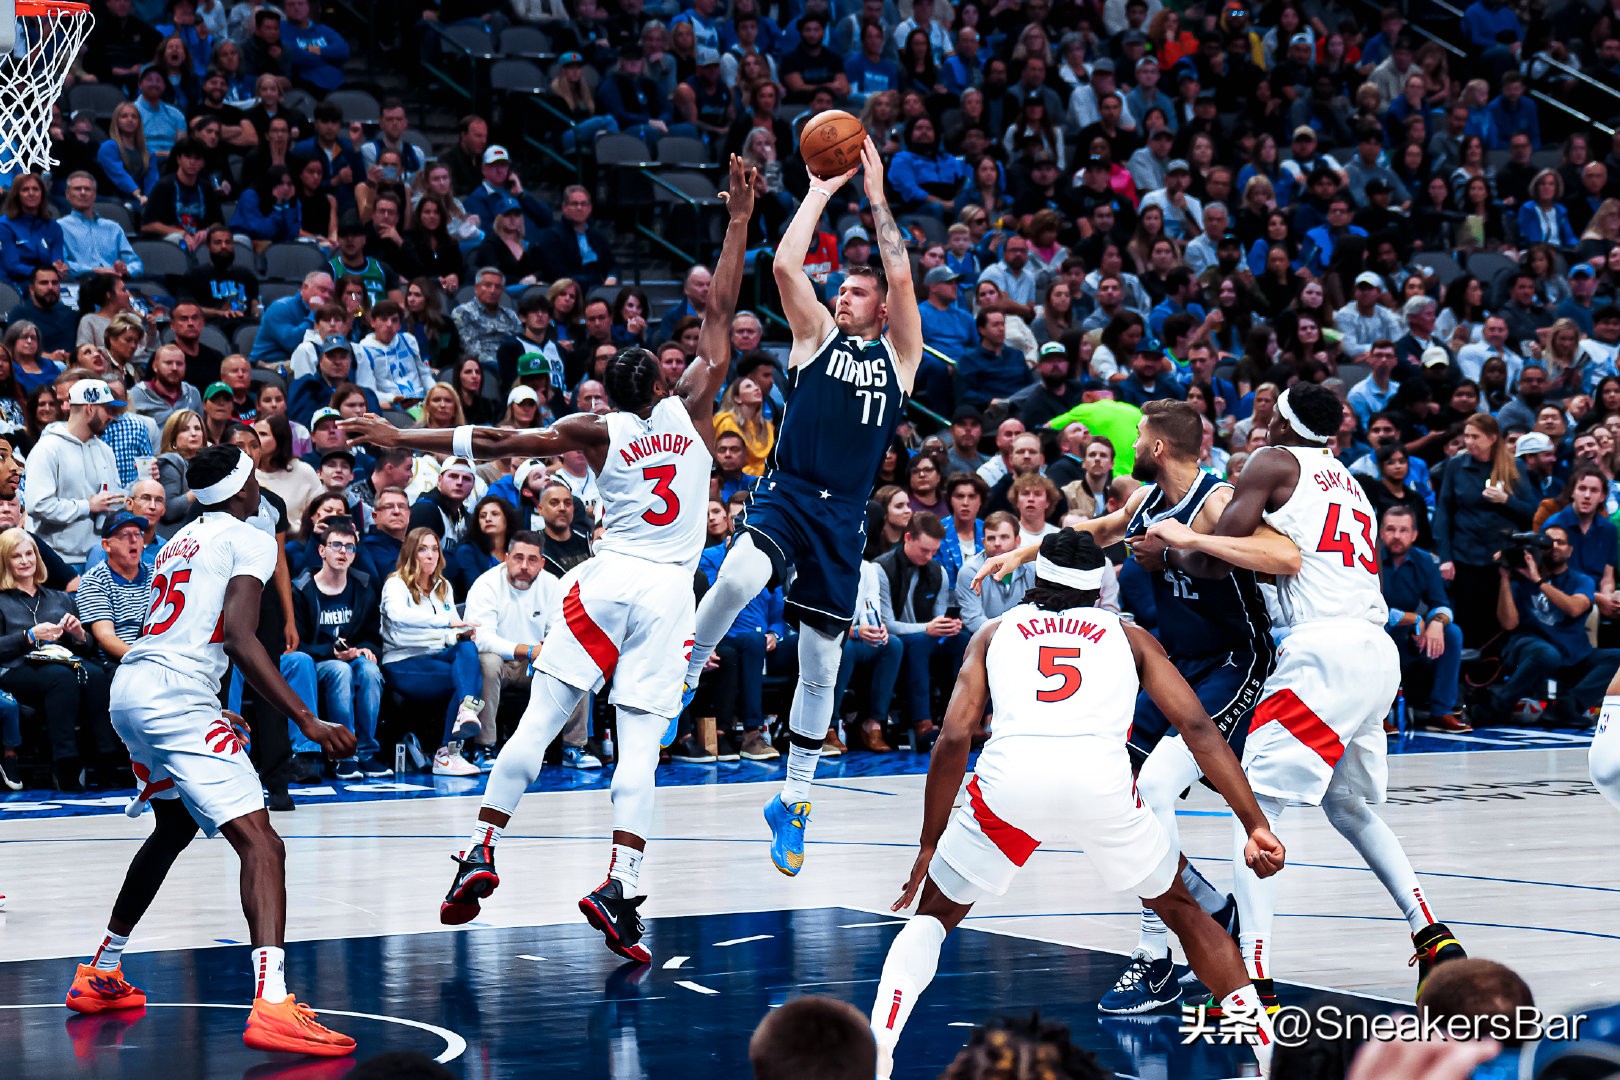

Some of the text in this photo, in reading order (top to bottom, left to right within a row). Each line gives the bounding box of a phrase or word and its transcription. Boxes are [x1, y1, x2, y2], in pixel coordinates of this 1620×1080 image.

[855, 389, 887, 427] 77
[619, 433, 694, 467] ANUNOBY
[640, 463, 681, 527] 3
[1315, 502, 1379, 575] 43
[143, 568, 192, 637] 25
[1016, 617, 1107, 644] ACHIUWA
[1036, 645, 1083, 703] 5
